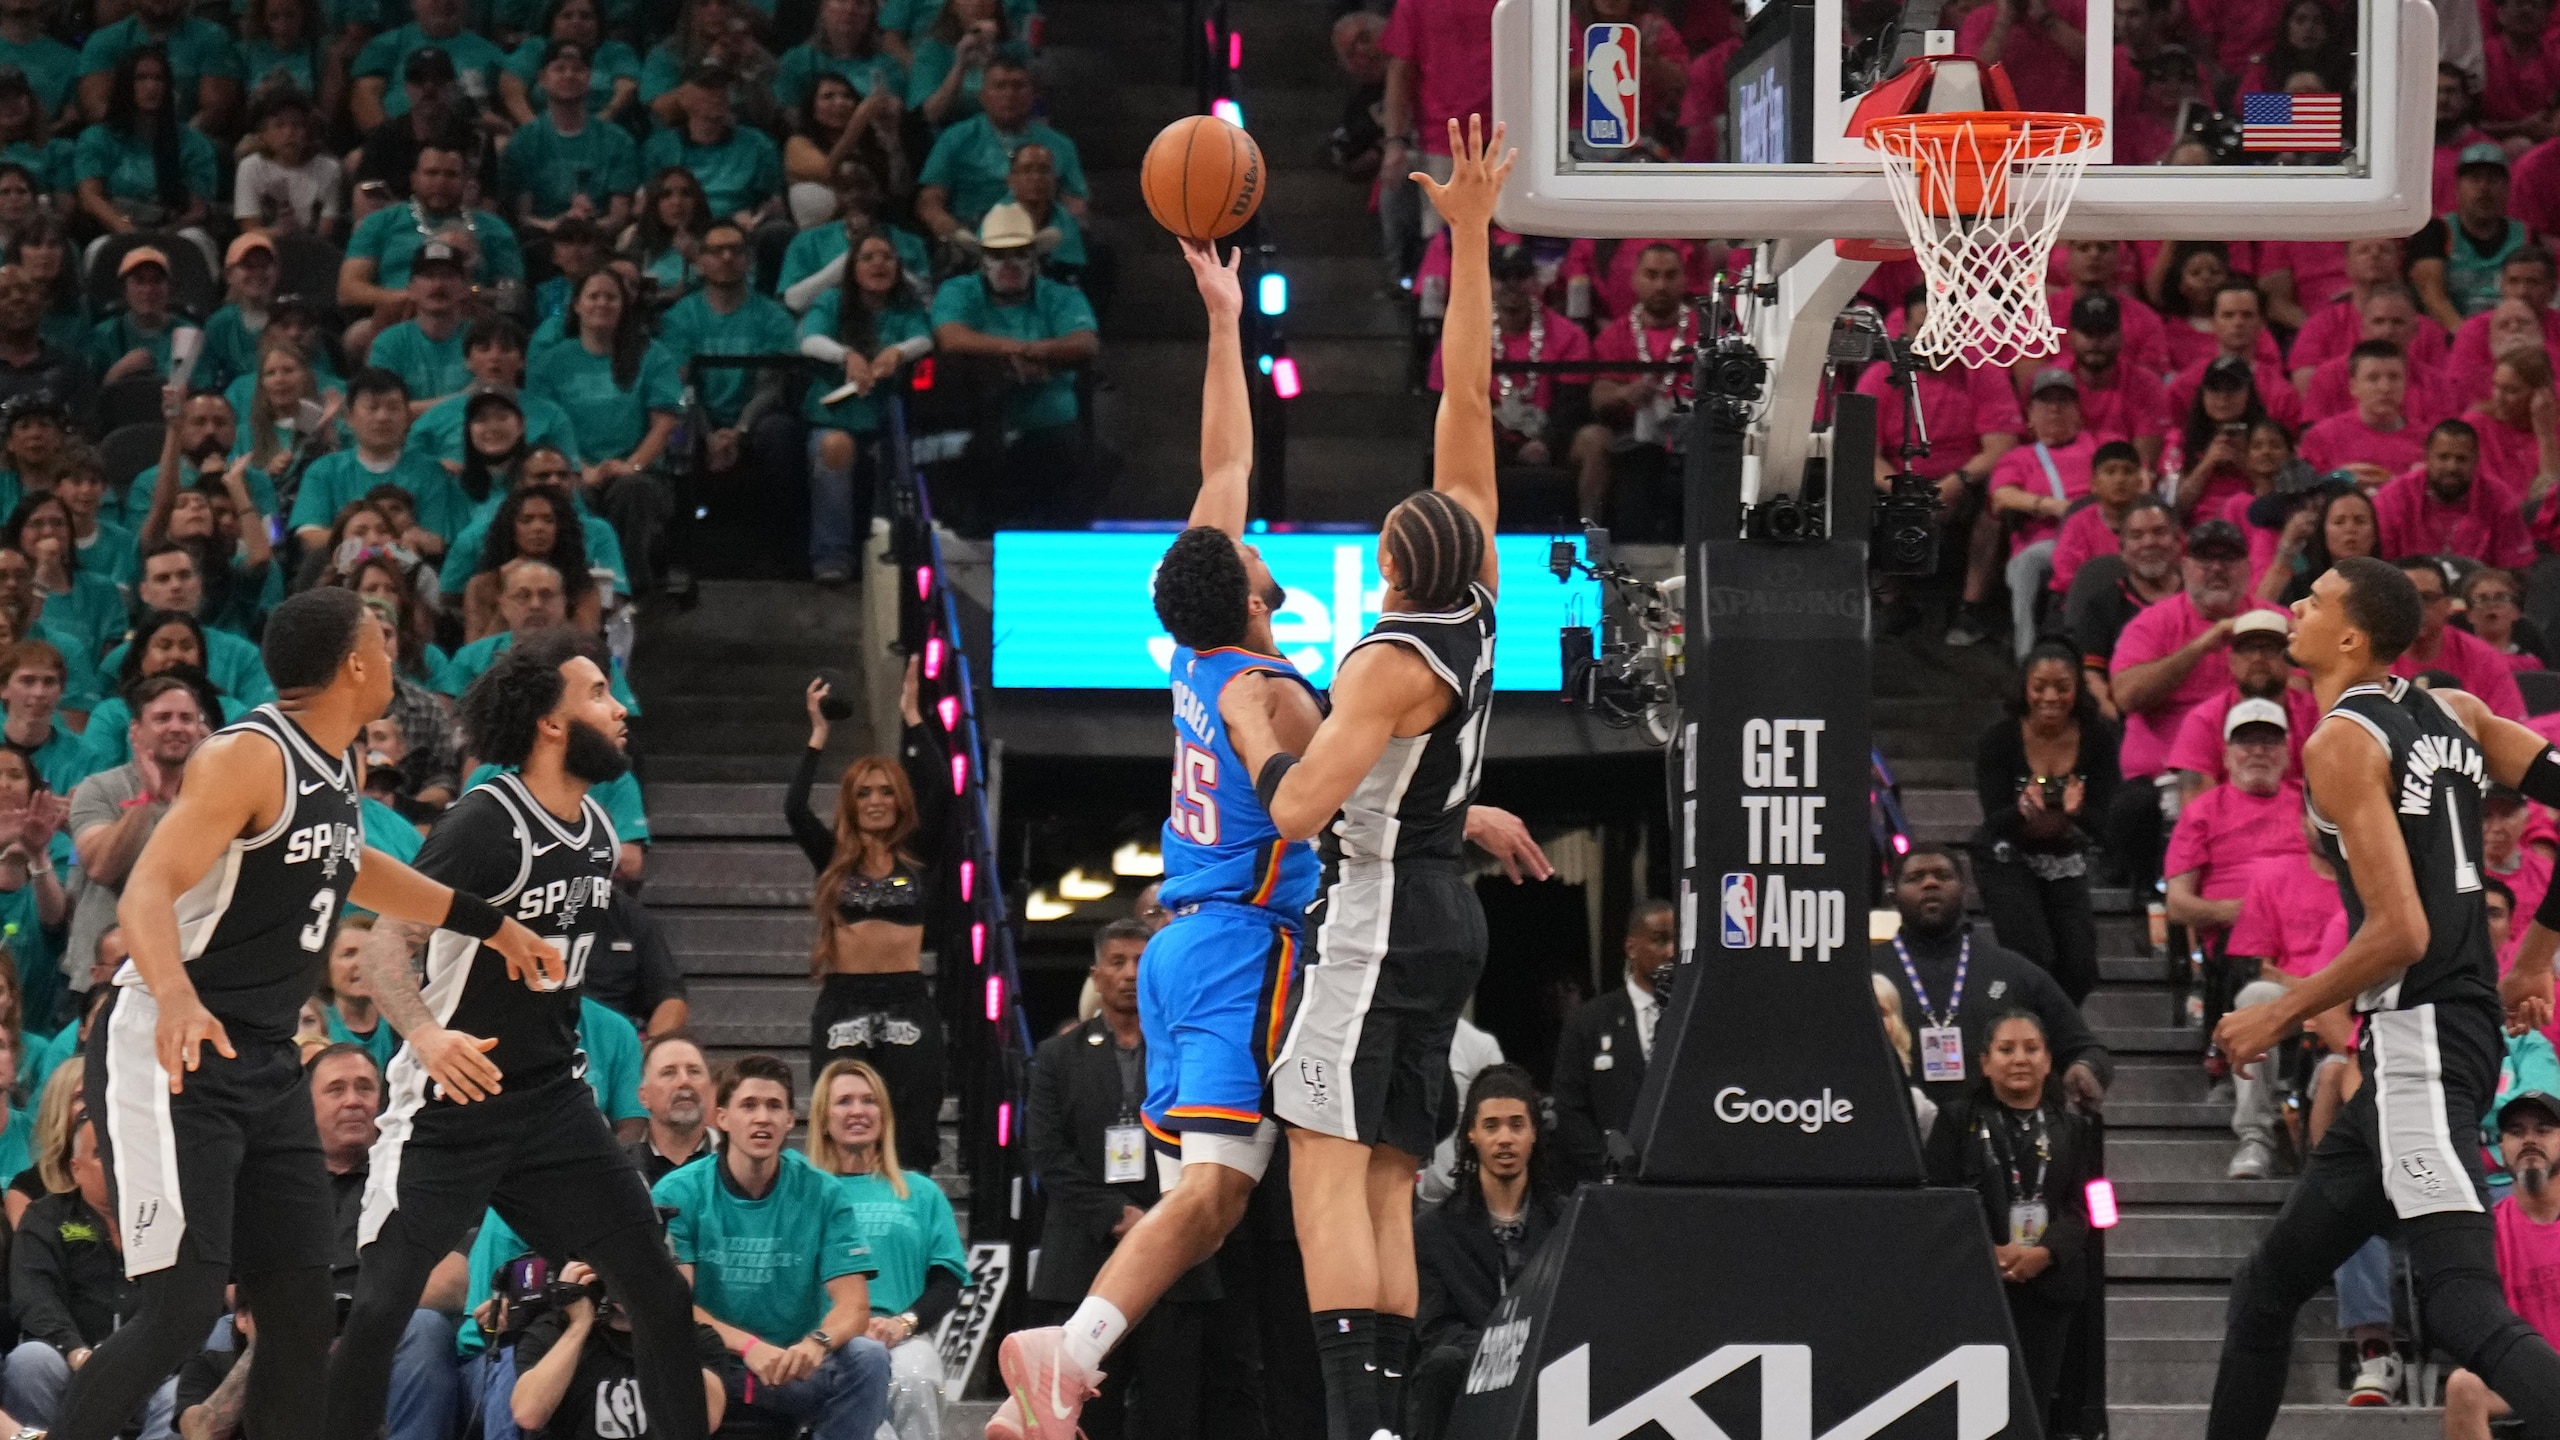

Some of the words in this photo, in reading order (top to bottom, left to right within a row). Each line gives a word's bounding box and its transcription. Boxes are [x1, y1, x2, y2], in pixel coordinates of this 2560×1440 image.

[1591, 119, 1618, 139] NBA
[1742, 718, 1826, 788] GET
[1741, 796, 1826, 865] THE
[2445, 786, 2484, 894] 1
[299, 887, 336, 953] 3
[1760, 874, 1846, 962] App
[1713, 1086, 1854, 1133] Google
